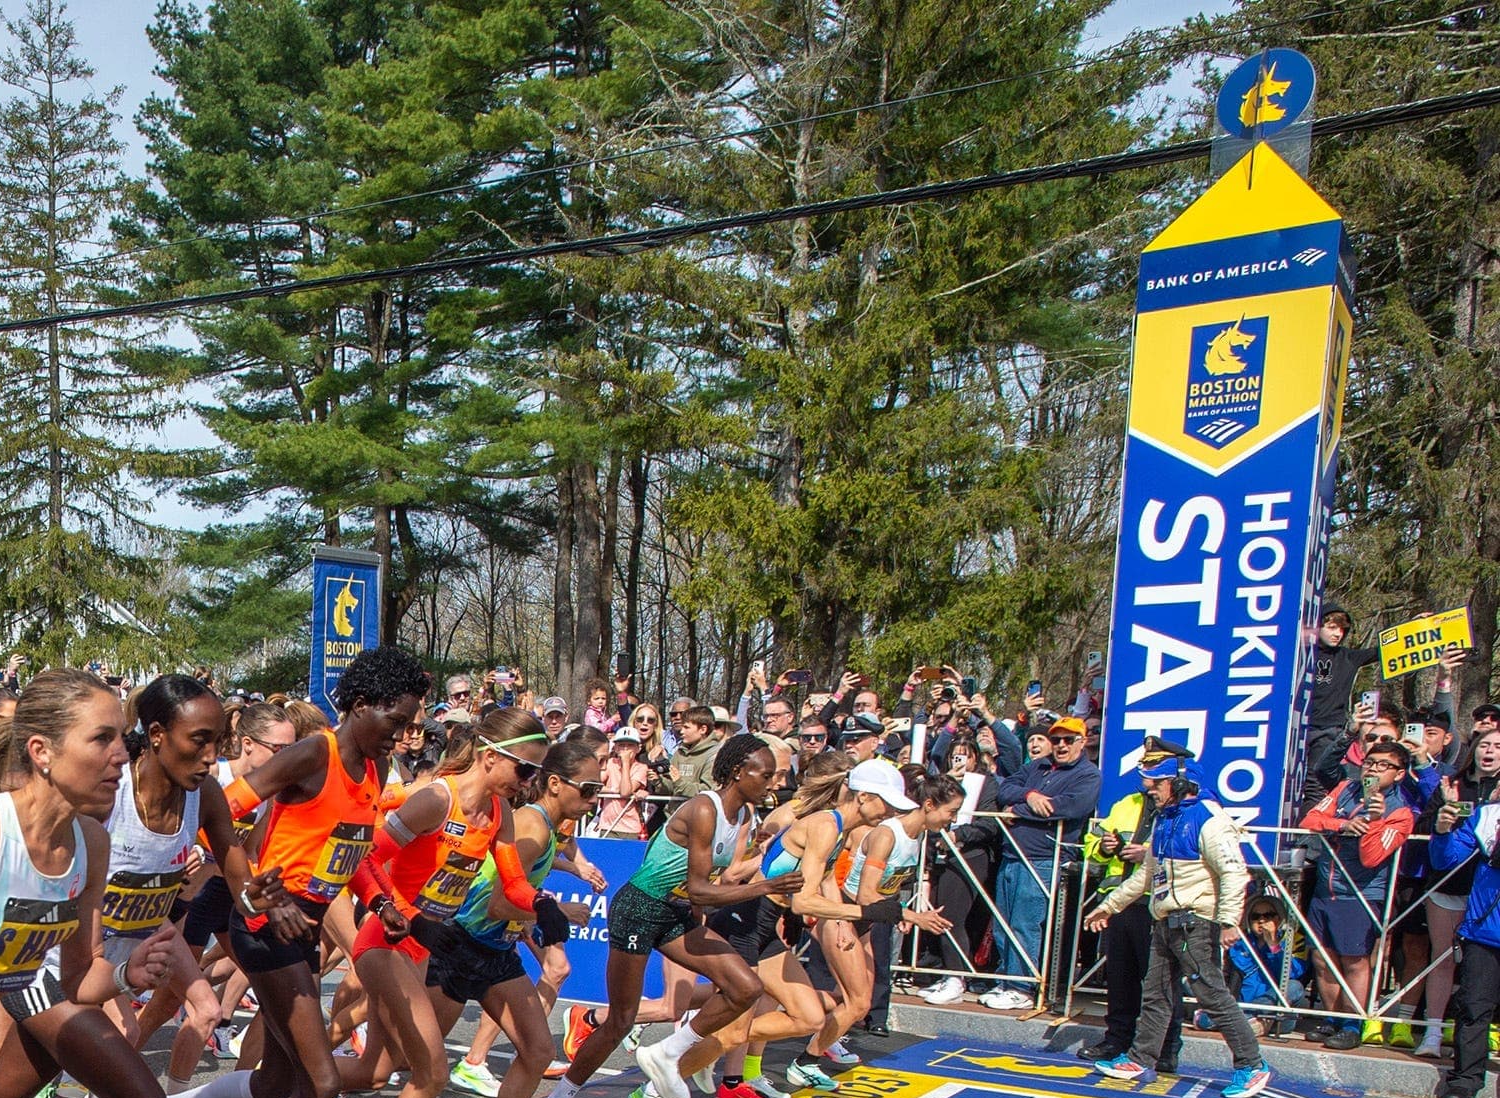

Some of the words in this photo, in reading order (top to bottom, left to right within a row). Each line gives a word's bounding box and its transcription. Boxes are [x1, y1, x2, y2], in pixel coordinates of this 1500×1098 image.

[1146, 273, 1189, 291] BANK
[1192, 270, 1213, 283] OF
[1215, 259, 1289, 281] AMERICA
[1189, 375, 1260, 397] BOSTON
[1188, 390, 1259, 409] MARATHON
[1187, 410, 1209, 418] BANK
[1221, 405, 1257, 415] AMERICA
[1118, 495, 1226, 778] STAR
[1404, 627, 1442, 649] RUN
[326, 641, 362, 656] BOSTON
[1217, 491, 1292, 846] HOPKINTON
